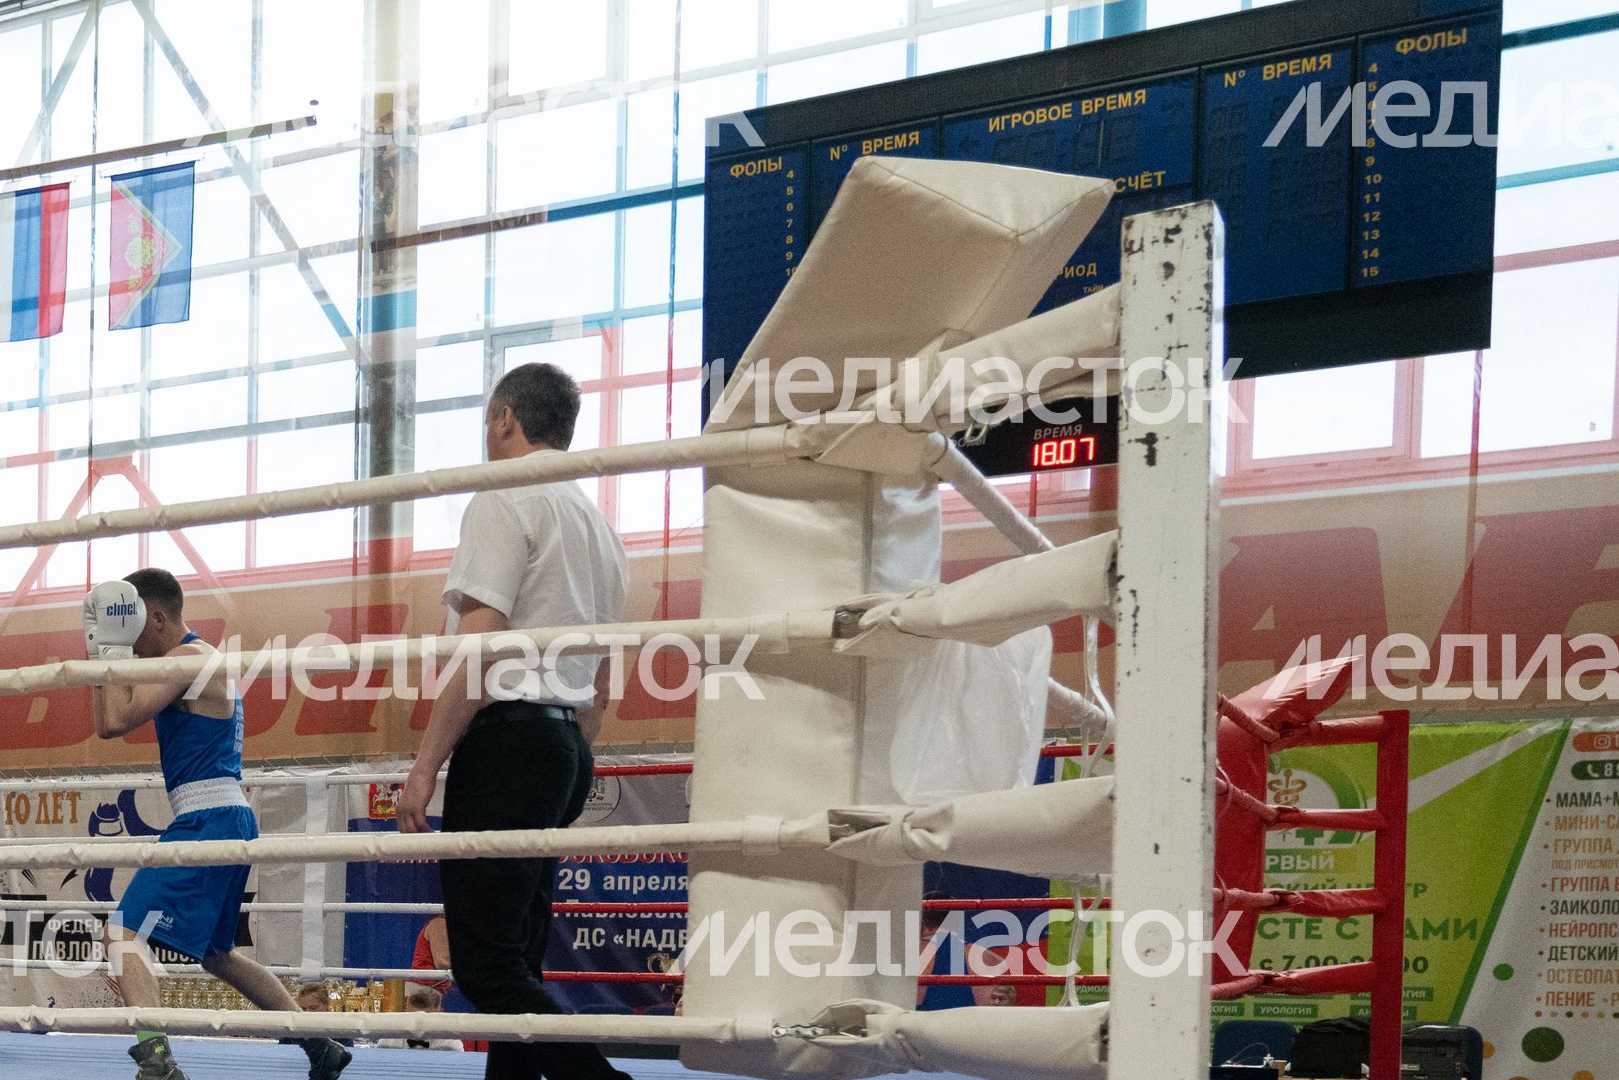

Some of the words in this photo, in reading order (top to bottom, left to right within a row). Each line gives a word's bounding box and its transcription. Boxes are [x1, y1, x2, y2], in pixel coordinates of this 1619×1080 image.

[1395, 27, 1469, 55] ФОЛЫ
[1262, 53, 1332, 81] ВРЕМЯ
[1368, 62, 1378, 73] 4
[1368, 81, 1377, 92] 5
[988, 103, 1072, 133] ИГРОВОЕ
[1081, 89, 1147, 116] ВРЕМЯ
[862, 131, 920, 156] ВРЕМЯ
[730, 156, 782, 178] ФОЛЫ
[1365, 156, 1375, 167] 9
[786, 170, 794, 179] 4
[1365, 174, 1382, 185] 10
[1114, 171, 1166, 194] СЧЁТ
[786, 186, 794, 195] 5
[1364, 193, 1381, 204] 11
[786, 203, 794, 211] 6
[1363, 211, 1381, 222] 12
[786, 219, 794, 228] 7
[786, 235, 794, 244] 8
[1362, 230, 1380, 240] 13
[785, 251, 793, 260] 9
[1362, 248, 1380, 259] 14
[1361, 267, 1379, 278] 15
[1033, 424, 1083, 441] ВРЕМЯ
[4, 791, 30, 825] 10
[35, 791, 82, 825] ЛЕТ
[1554, 837, 1613, 854] ГРУППА
[558, 868, 591, 890] 29
[1551, 877, 1610, 892] ГРУППА
[573, 928, 606, 950] ДС
[1547, 943, 1619, 962] ДЕТСКИЙ
[1545, 991, 1595, 1007] ПЕНИЕ
[1260, 1006, 1312, 1015] УРОЛОГИЯ
